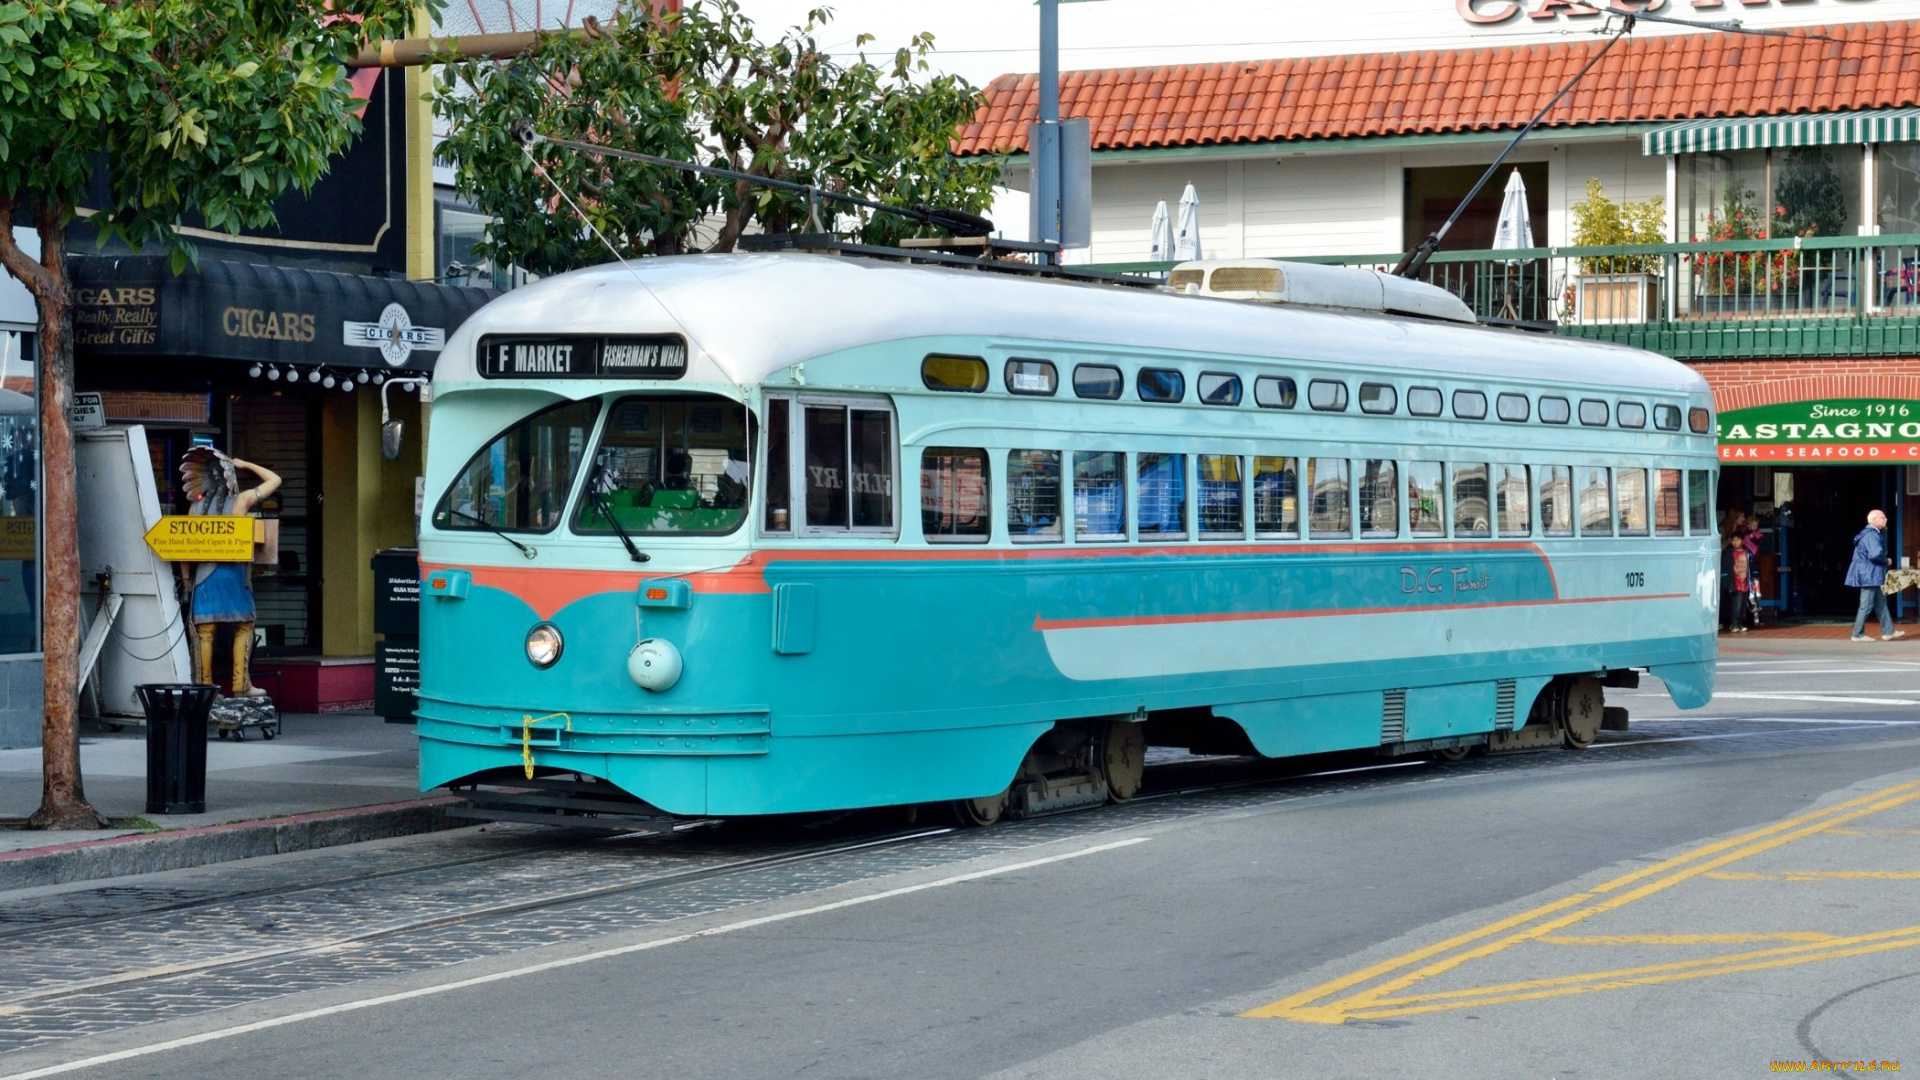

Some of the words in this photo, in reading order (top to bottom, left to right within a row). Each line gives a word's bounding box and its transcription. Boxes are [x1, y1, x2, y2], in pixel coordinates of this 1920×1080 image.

[114, 307, 157, 326] Really
[222, 306, 316, 342] CIGARS
[75, 328, 115, 344] Great
[120, 328, 156, 344] Gifts
[499, 345, 509, 372] F
[515, 345, 573, 372] MARKET
[602, 345, 659, 367] FISHERMAN'S
[1809, 404, 1861, 419] Since
[1865, 404, 1910, 417] 1916
[1786, 447, 1879, 458] SEAFOOD
[169, 521, 235, 535] STOGIES
[1626, 572, 1645, 588] 1076
